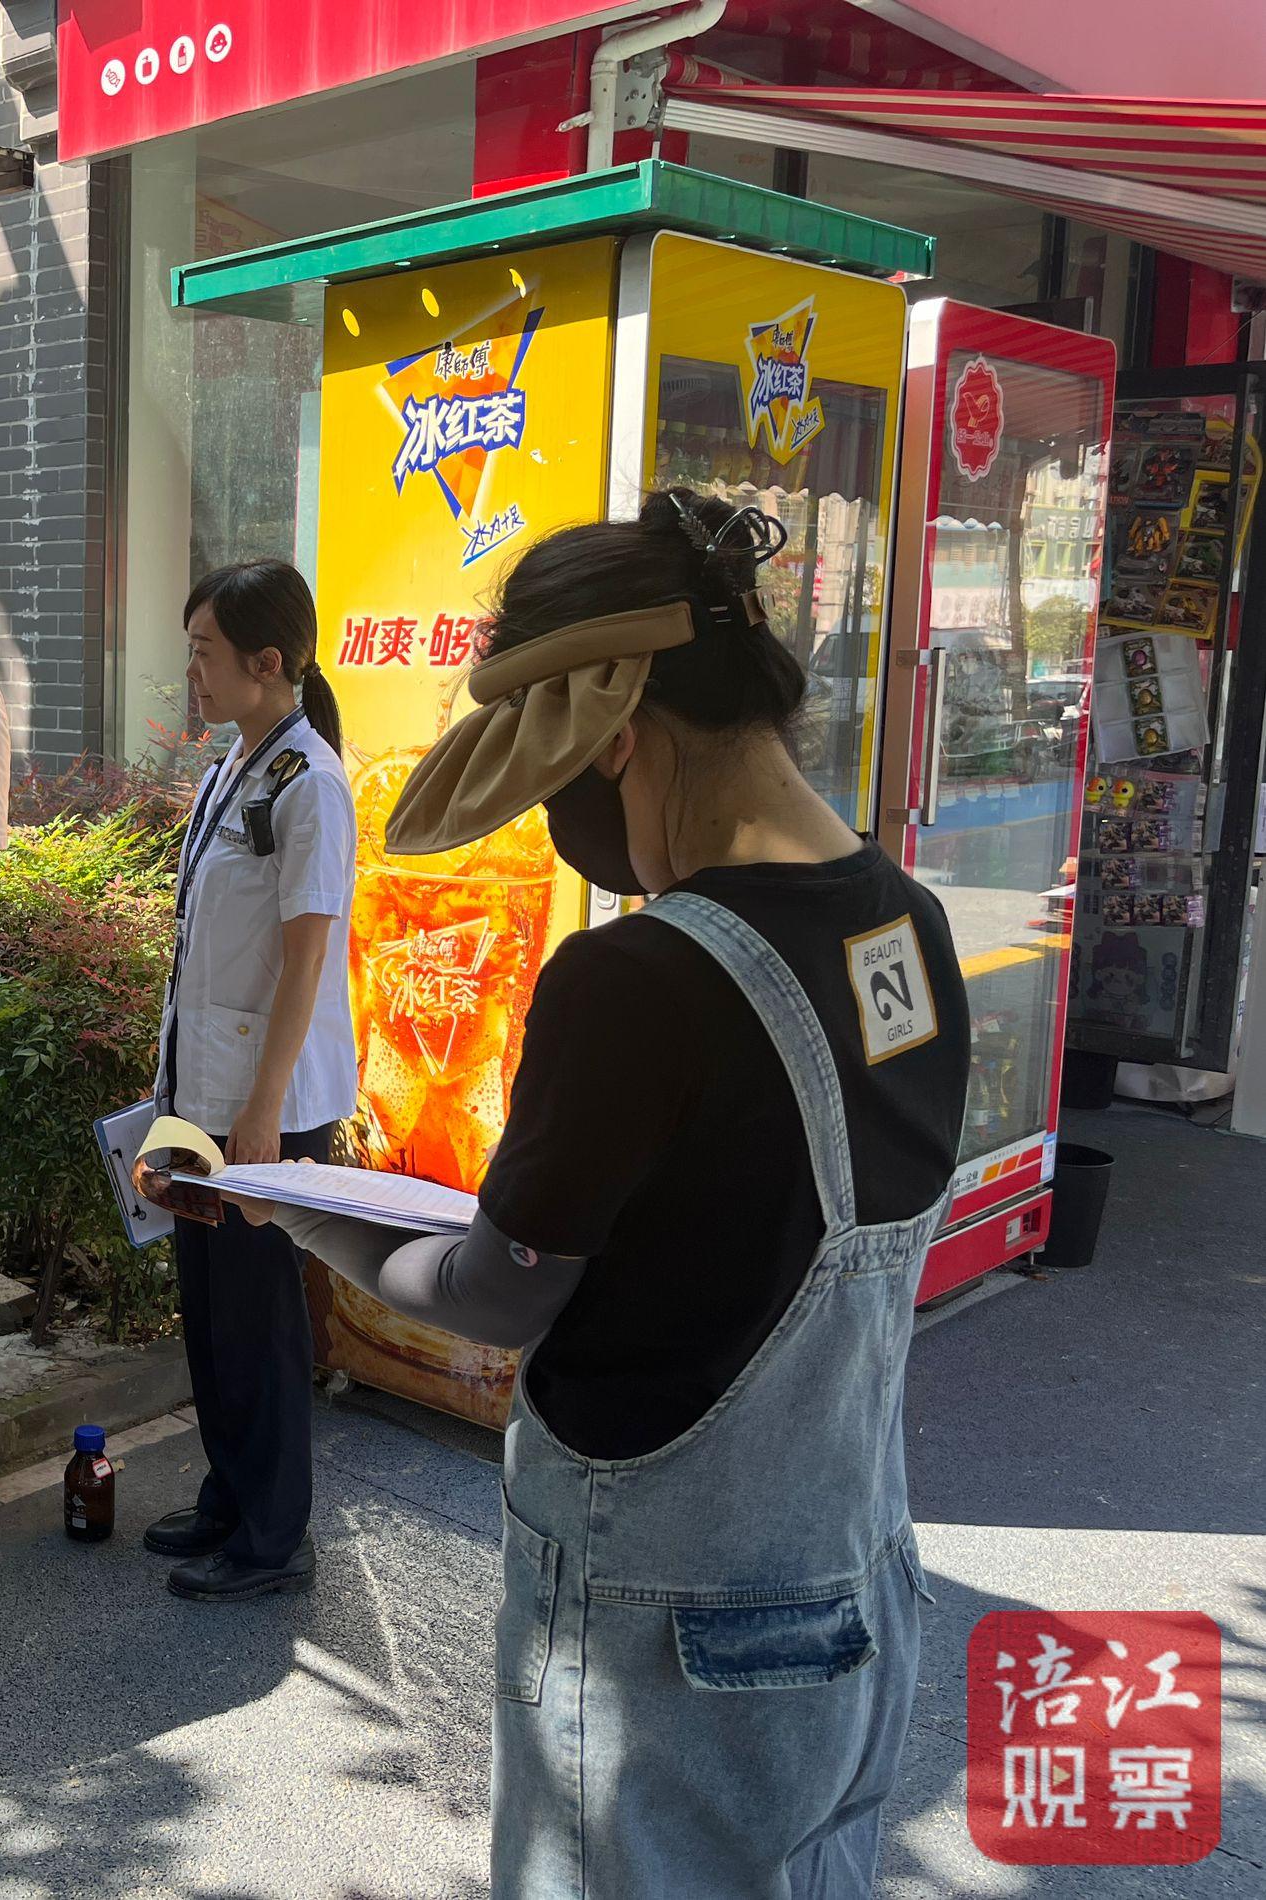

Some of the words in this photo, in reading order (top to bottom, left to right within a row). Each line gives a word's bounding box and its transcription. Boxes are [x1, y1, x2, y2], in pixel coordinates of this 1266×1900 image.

[753, 356, 804, 405] 冰红茶
[394, 393, 522, 480] 冰红茶
[863, 937, 903, 967] BEAUTY
[389, 969, 481, 1023] 冰红茶
[887, 1019, 914, 1042] GIRLS
